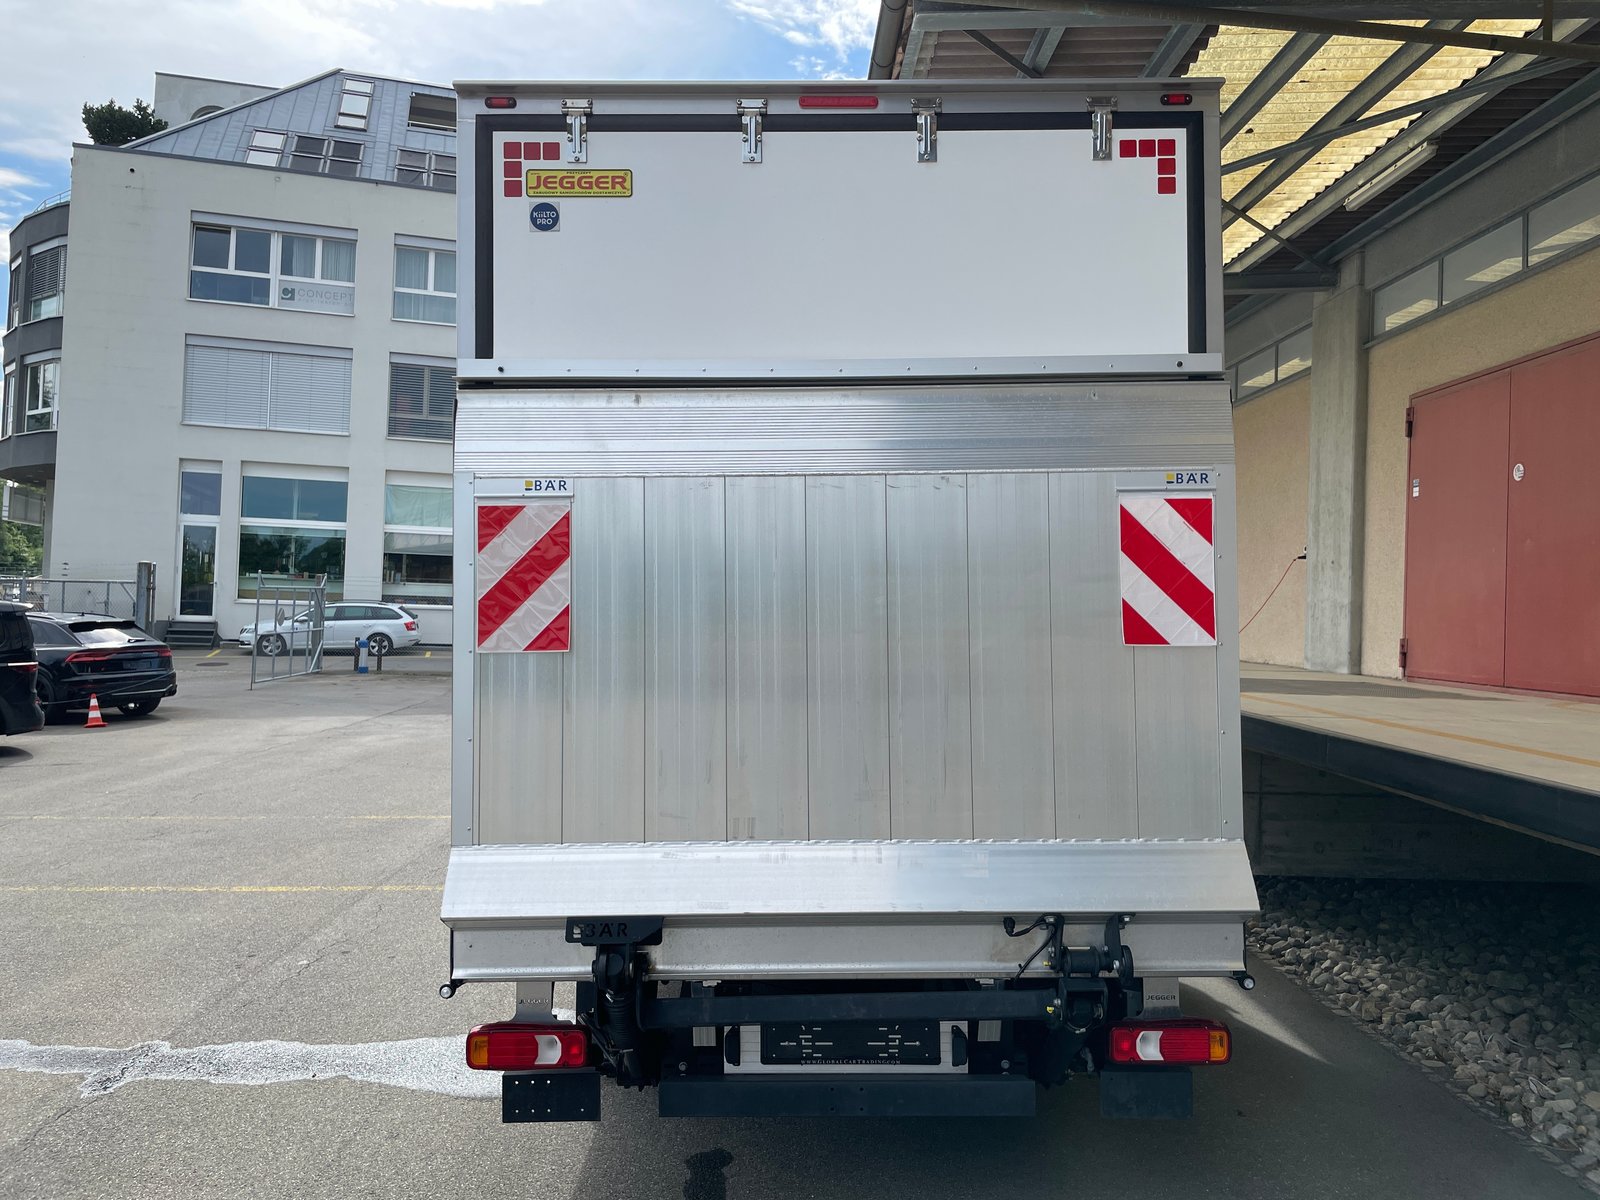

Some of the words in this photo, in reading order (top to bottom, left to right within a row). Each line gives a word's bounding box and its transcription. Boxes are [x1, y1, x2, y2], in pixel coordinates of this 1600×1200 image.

[528, 175, 627, 190] JEGGER
[297, 288, 354, 302] CONCEPT
[1175, 472, 1209, 484] BÄR
[534, 479, 567, 491] BÄR
